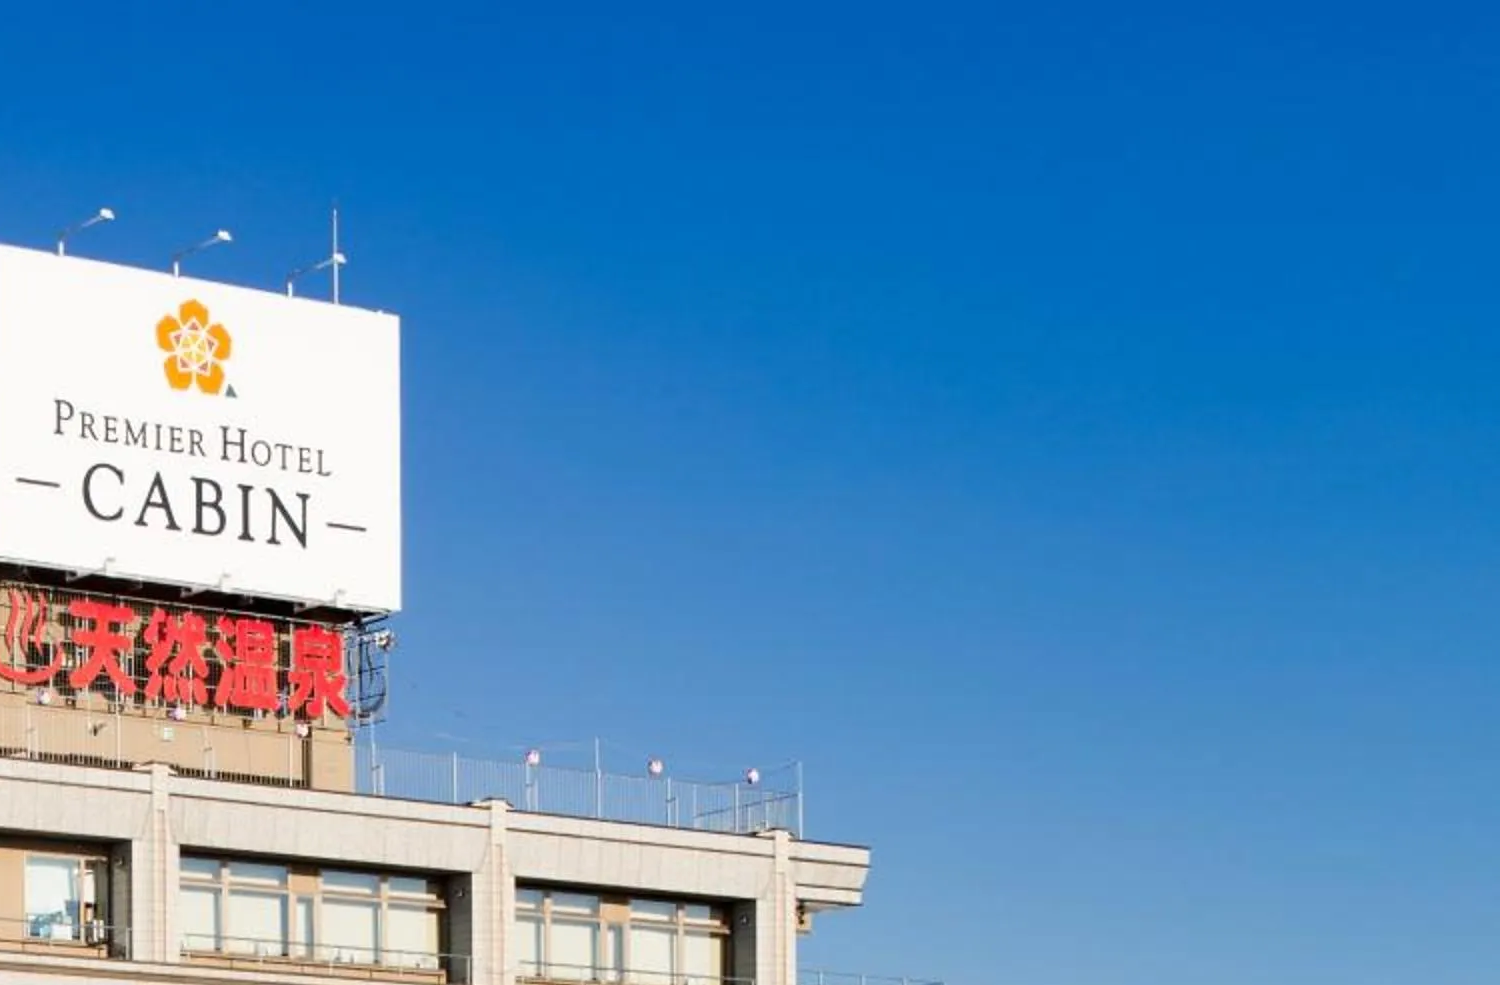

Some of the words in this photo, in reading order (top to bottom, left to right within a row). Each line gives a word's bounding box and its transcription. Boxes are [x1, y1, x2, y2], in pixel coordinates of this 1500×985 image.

[52, 398, 208, 458] PREMIER
[219, 424, 332, 477] HOTEL
[81, 461, 311, 550] CABIN
[67, 598, 351, 718] 天然温泉
